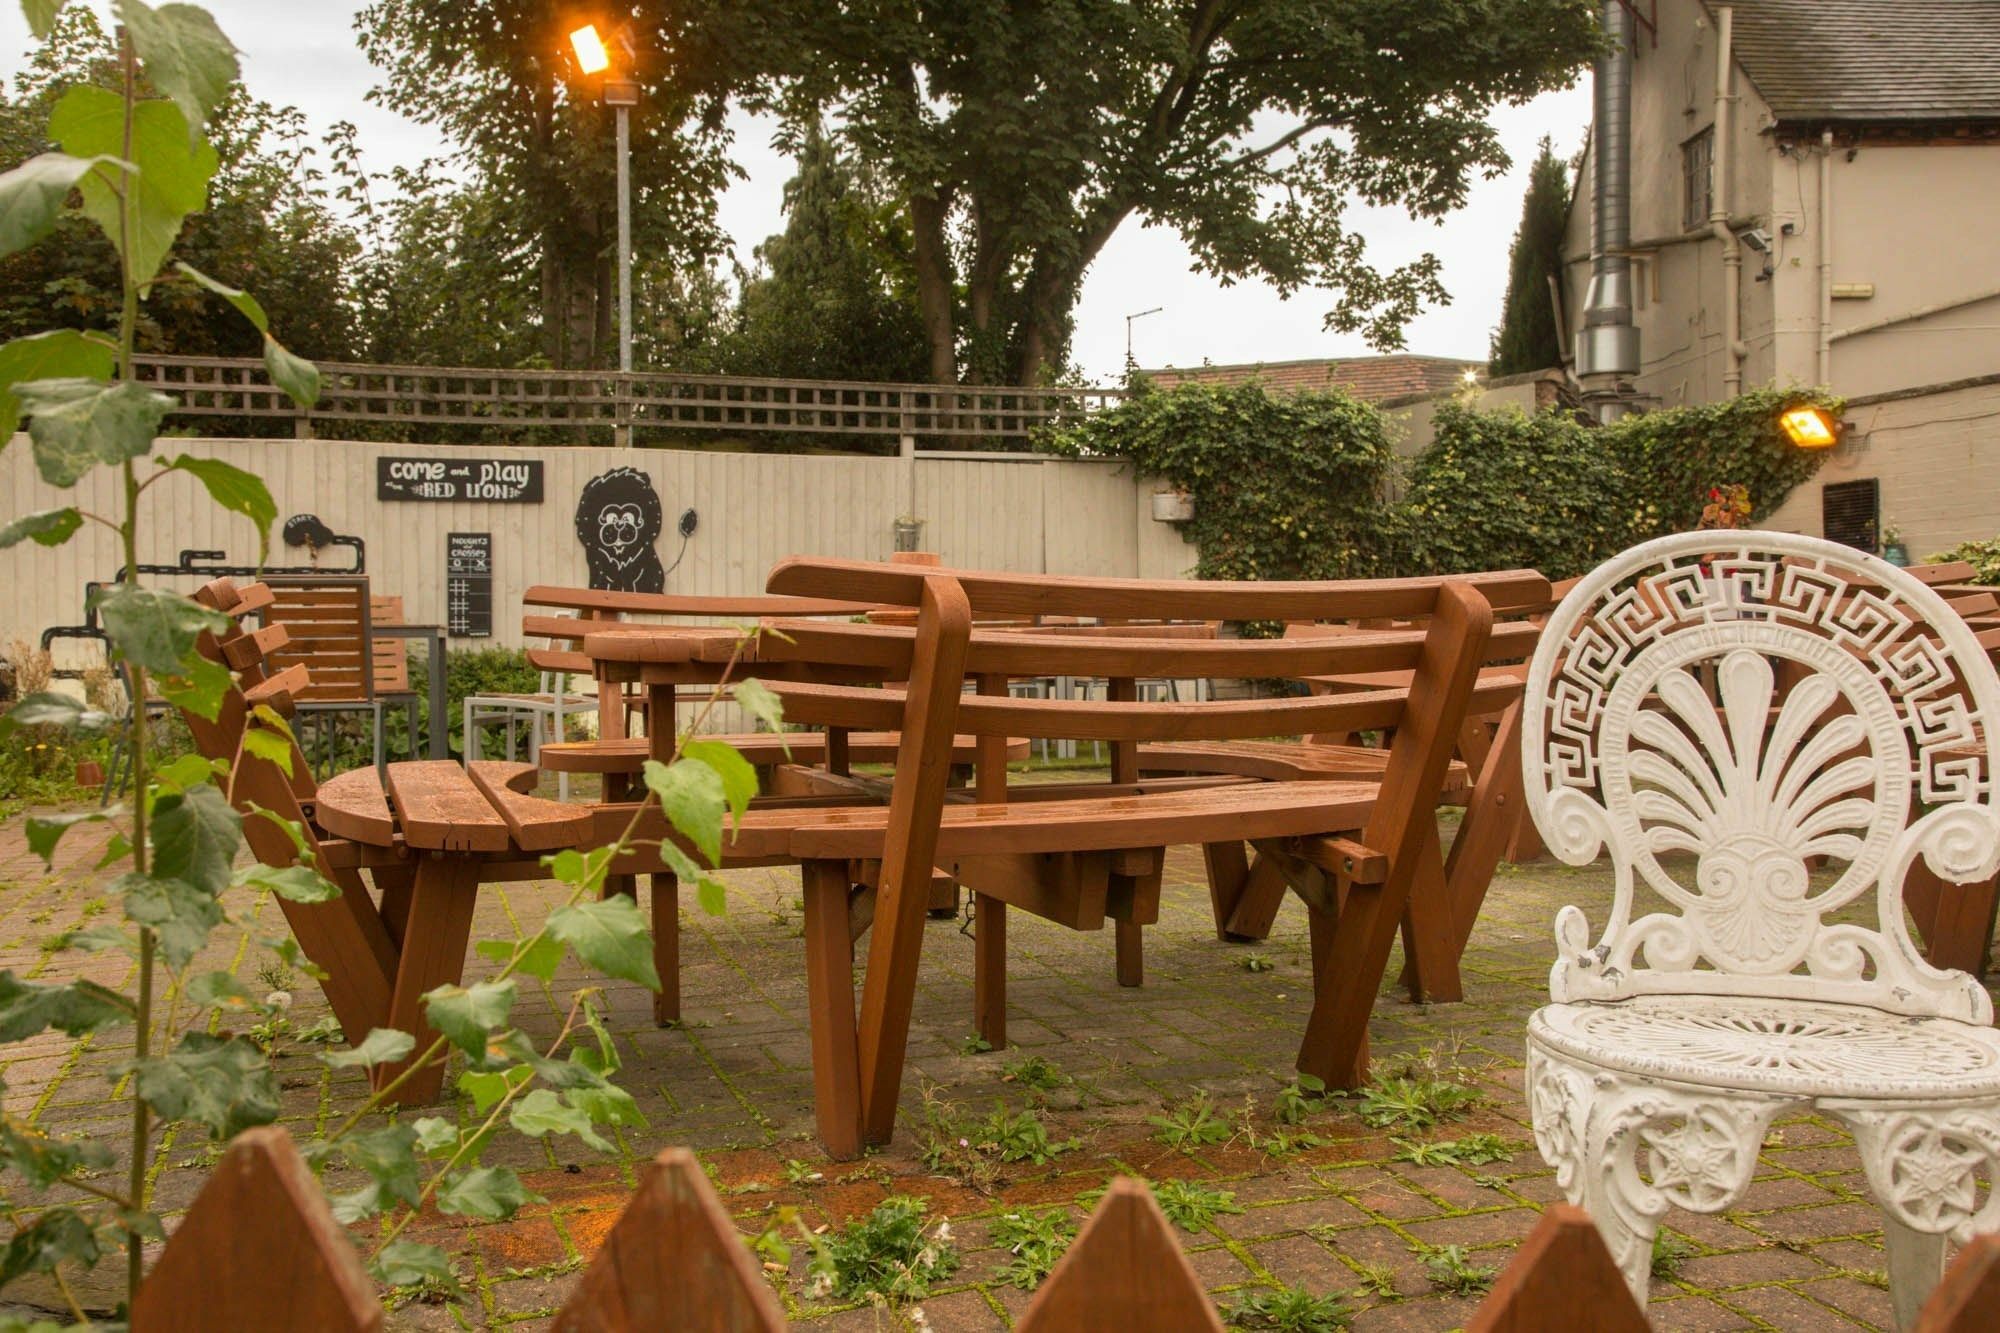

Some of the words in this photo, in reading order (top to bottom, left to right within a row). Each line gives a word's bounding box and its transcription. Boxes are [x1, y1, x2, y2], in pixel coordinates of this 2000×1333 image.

[390, 461, 446, 480] come
[450, 466, 471, 476] and
[480, 461, 529, 488] play
[423, 482, 456, 498] RED
[466, 483, 508, 499] LION
[452, 537, 488, 545] NOUGHTS
